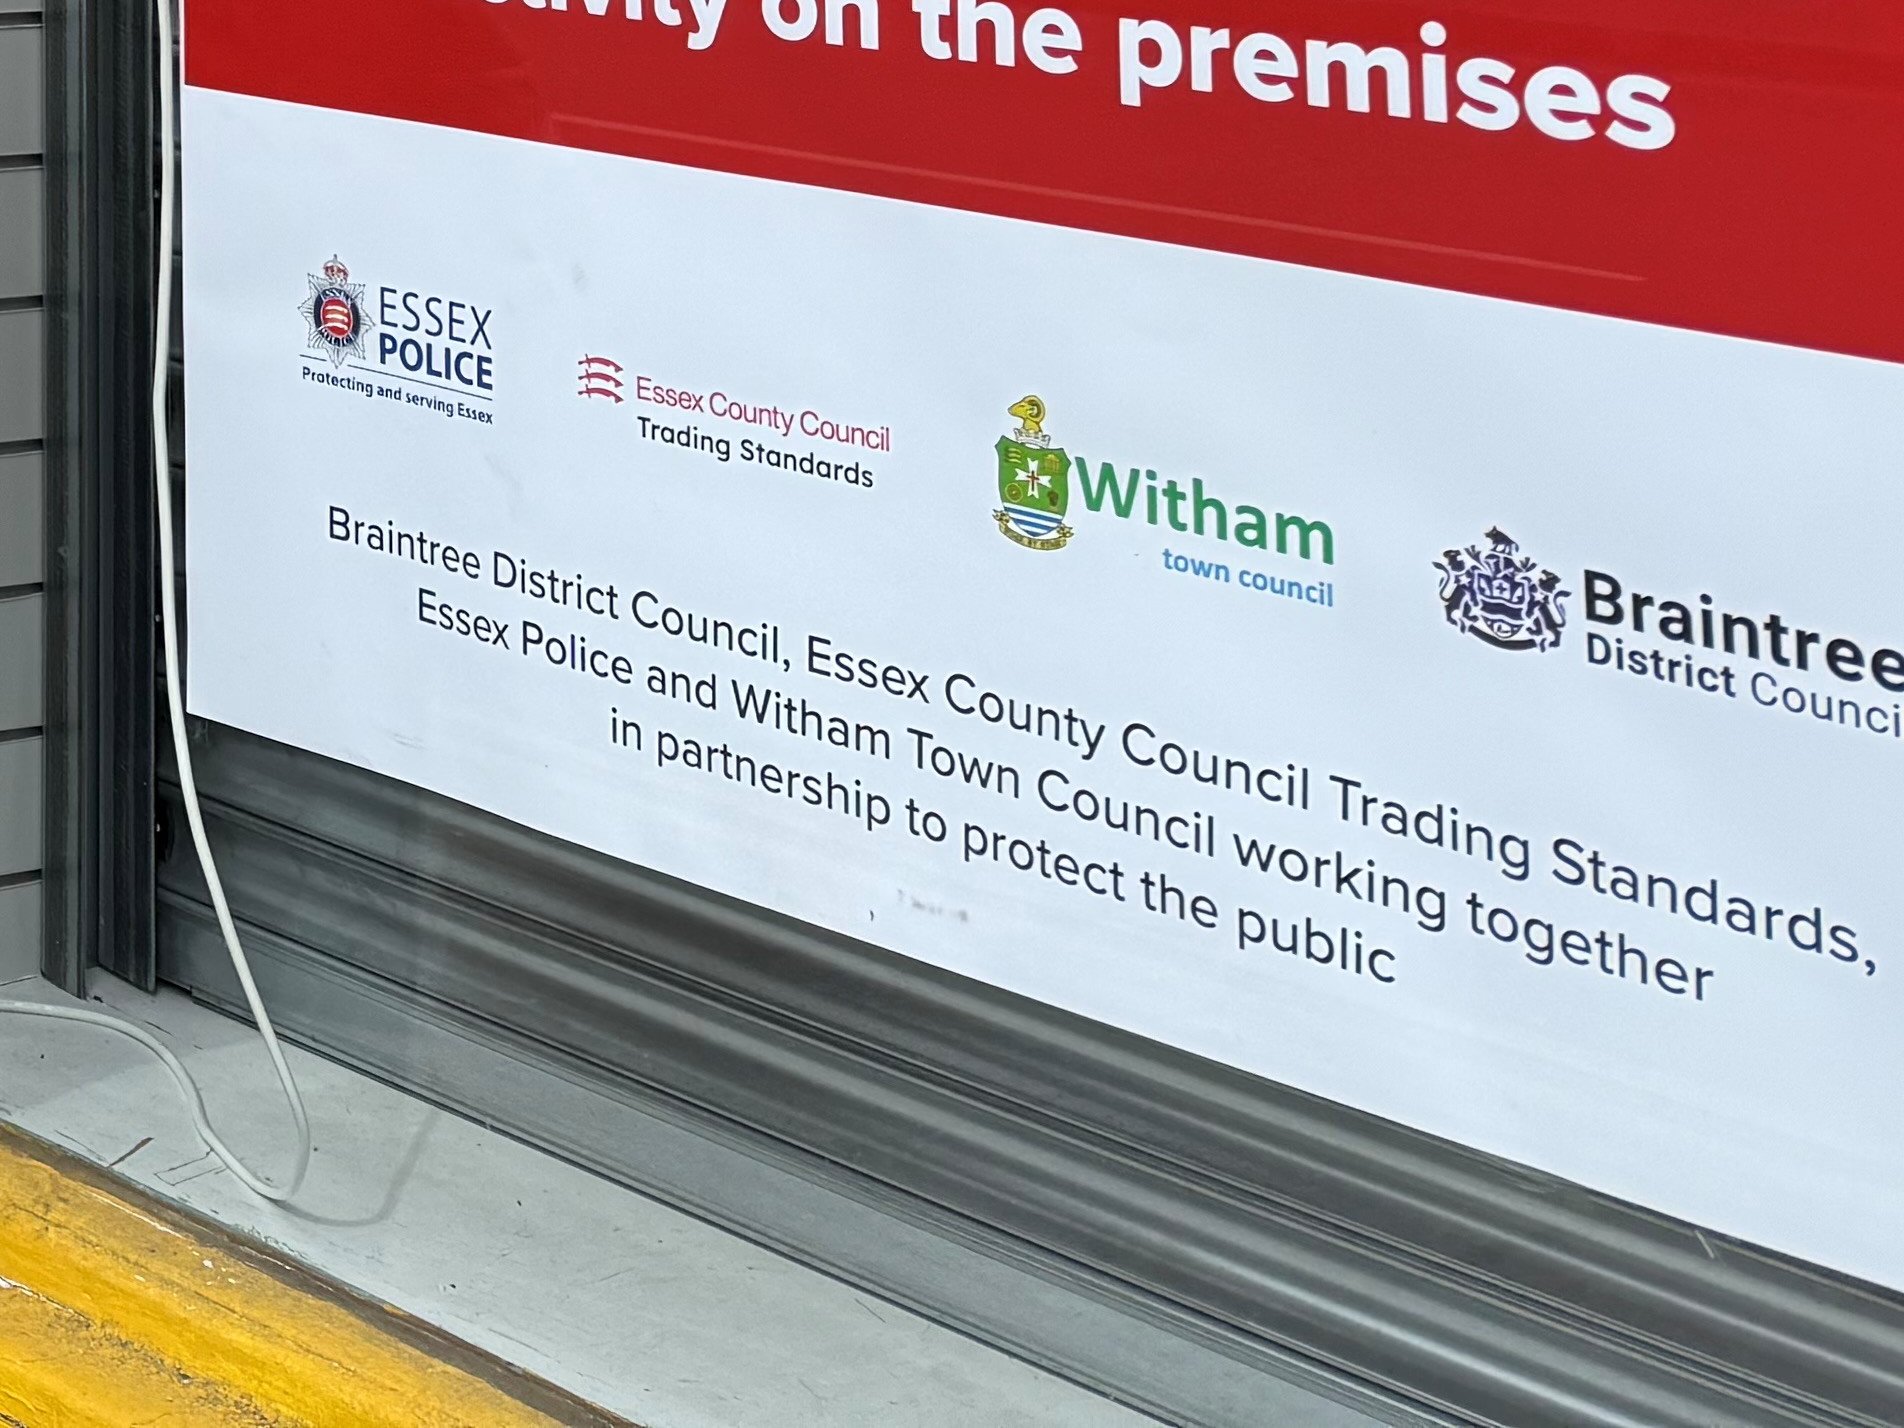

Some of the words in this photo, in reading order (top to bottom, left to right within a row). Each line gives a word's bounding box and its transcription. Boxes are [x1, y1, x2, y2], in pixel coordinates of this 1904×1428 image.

[1118, 18, 1676, 149] premises
[379, 332, 493, 391] POLICE
[380, 286, 492, 350] ESSEX
[302, 366, 373, 397] Protecting
[376, 383, 402, 401] and
[405, 393, 454, 418] serving
[457, 403, 493, 425] Essex
[636, 375, 705, 413] Essex
[708, 391, 794, 436] County
[800, 410, 890, 452] Council
[637, 416, 730, 462] Trading
[740, 439, 874, 488] Standards
[1074, 456, 1335, 564] Witham
[1163, 549, 1230, 583] town
[1238, 569, 1334, 608] council
[1583, 568, 1904, 693] Braintree
[1586, 631, 1737, 698] District
[1750, 671, 1904, 738] Counci
[330, 506, 480, 579] Braintree
[494, 551, 619, 619] District
[632, 591, 791, 672] Council,
[808, 635, 930, 704] Essex
[945, 674, 1106, 761] County
[1122, 723, 1309, 810] Council
[1329, 775, 1530, 881] Trading
[1552, 838, 1878, 977] Standards,
[418, 587, 510, 649] Essex
[522, 620, 633, 685] Police
[647, 665, 717, 711] and
[731, 679, 890, 760] Witham
[906, 727, 1019, 799] Town
[1037, 769, 1214, 858] Council
[1232, 833, 1446, 933] working
[1465, 892, 1714, 1002] together
[611, 706, 642, 751] in
[657, 730, 891, 832] partnership
[904, 798, 947, 842] to
[964, 822, 1126, 902] protect
[1139, 871, 1218, 929] the
[1238, 907, 1396, 983] public
